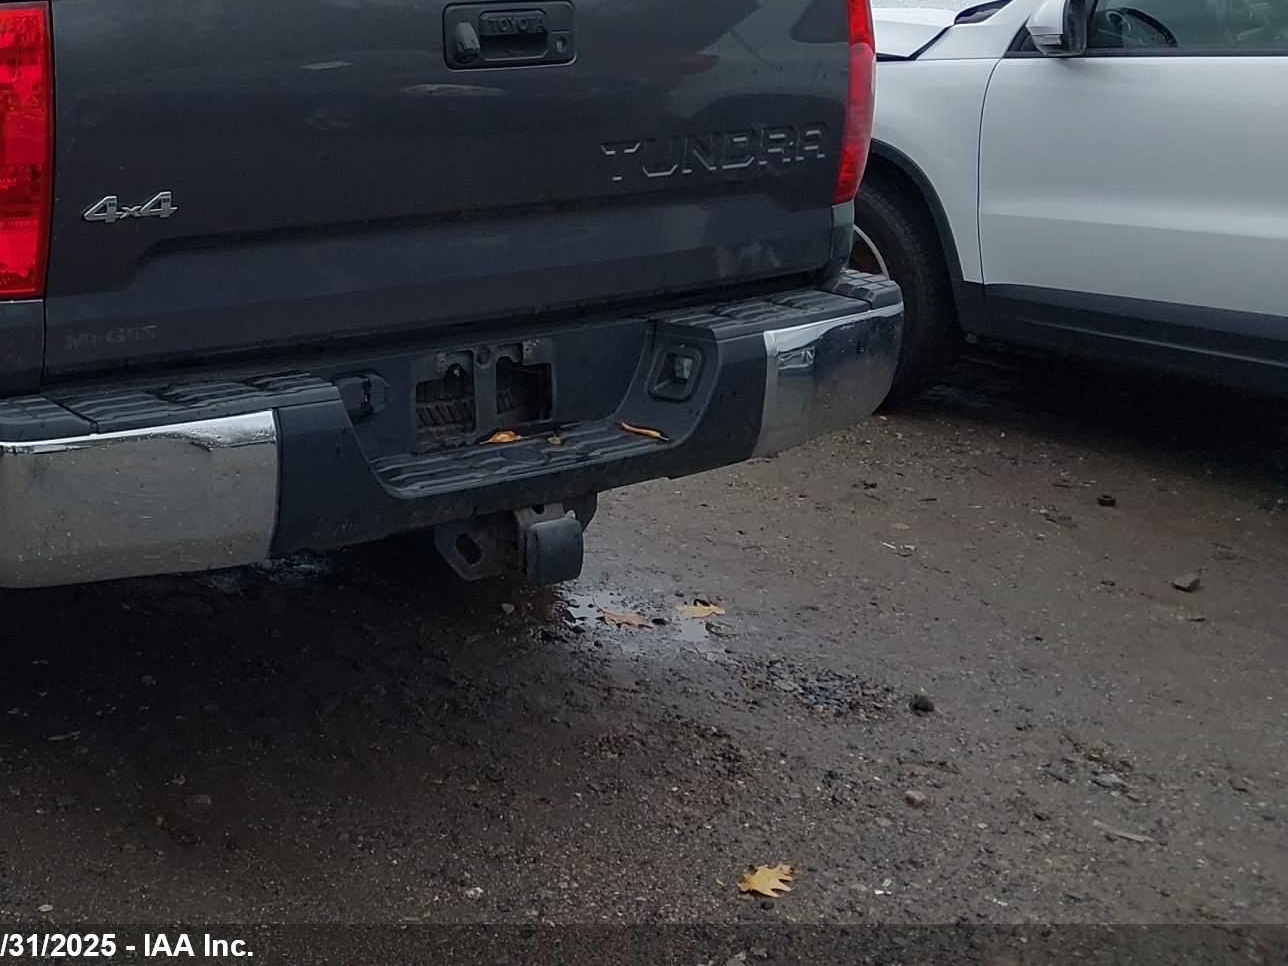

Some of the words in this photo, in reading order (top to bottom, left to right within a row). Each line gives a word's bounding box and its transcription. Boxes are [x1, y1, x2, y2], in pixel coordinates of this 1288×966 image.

[486, 16, 546, 35] TOYOTA
[599, 123, 826, 182] TUNDRA
[83, 191, 178, 223] 4x4
